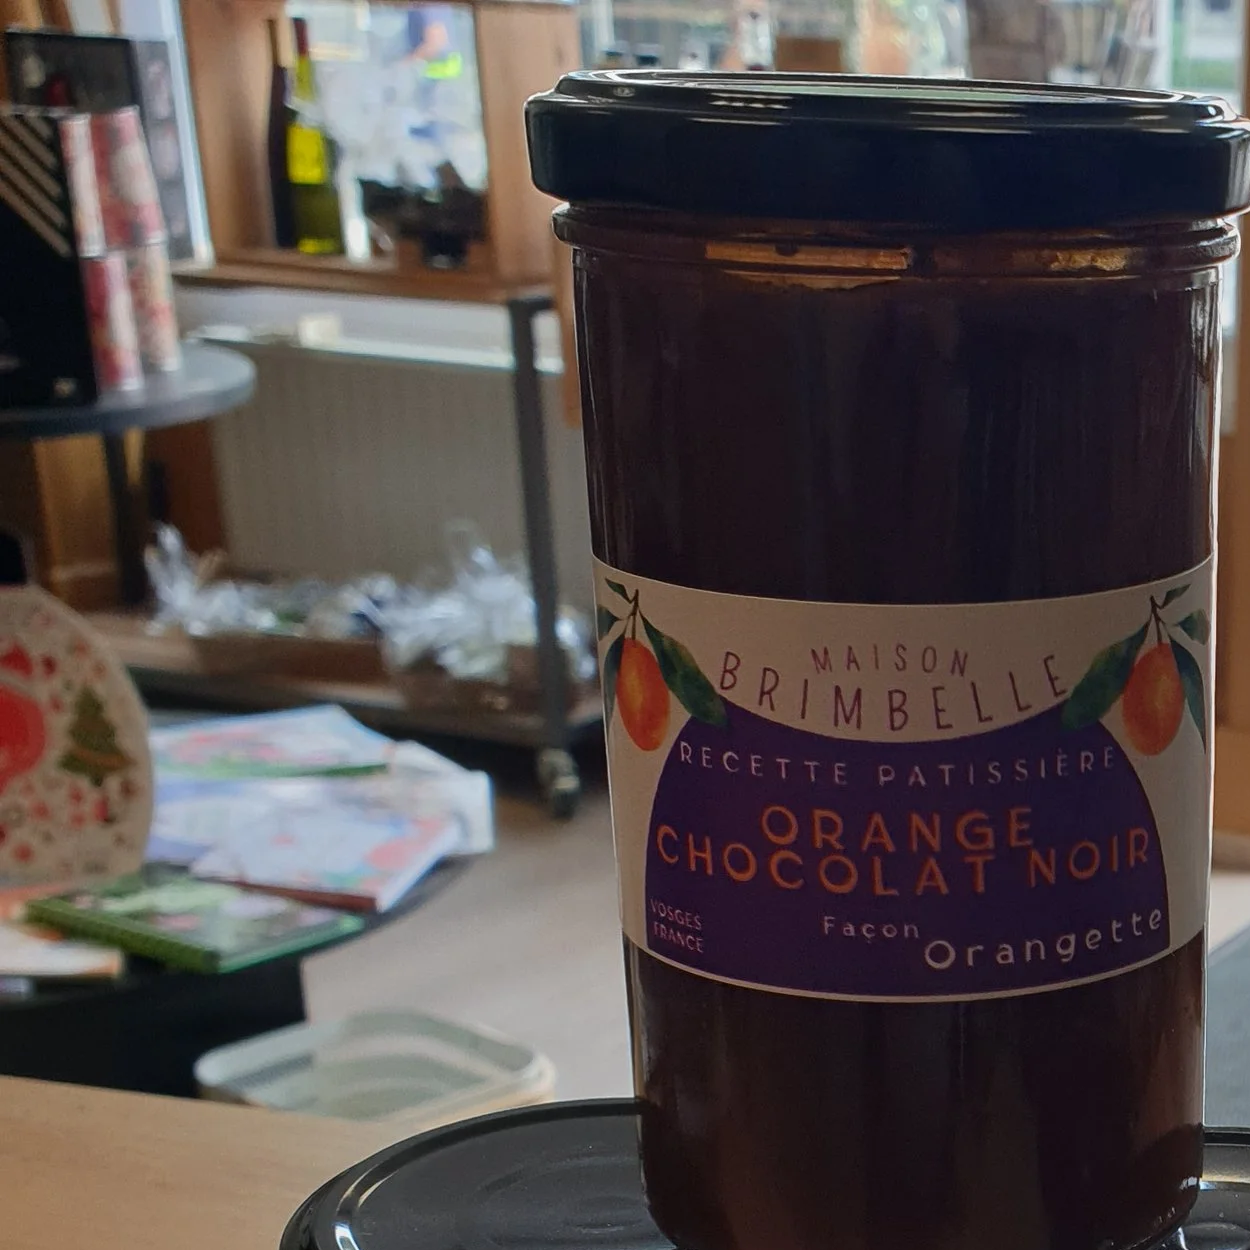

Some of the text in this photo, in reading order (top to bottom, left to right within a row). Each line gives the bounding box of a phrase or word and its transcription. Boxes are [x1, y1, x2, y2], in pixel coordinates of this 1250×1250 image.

[811, 645, 968, 677] MAISON
[718, 651, 1067, 732] BRIMBELLE
[680, 740, 1114, 786] RECETTE PATISSIÈRE
[761, 806, 1033, 853] ORANGE
[656, 825, 1150, 896] CHOCOLAT NOIR
[649, 899, 702, 930] VOSGES
[652, 922, 704, 954] FRANCE
[823, 908, 1162, 969] Façon Orangette
